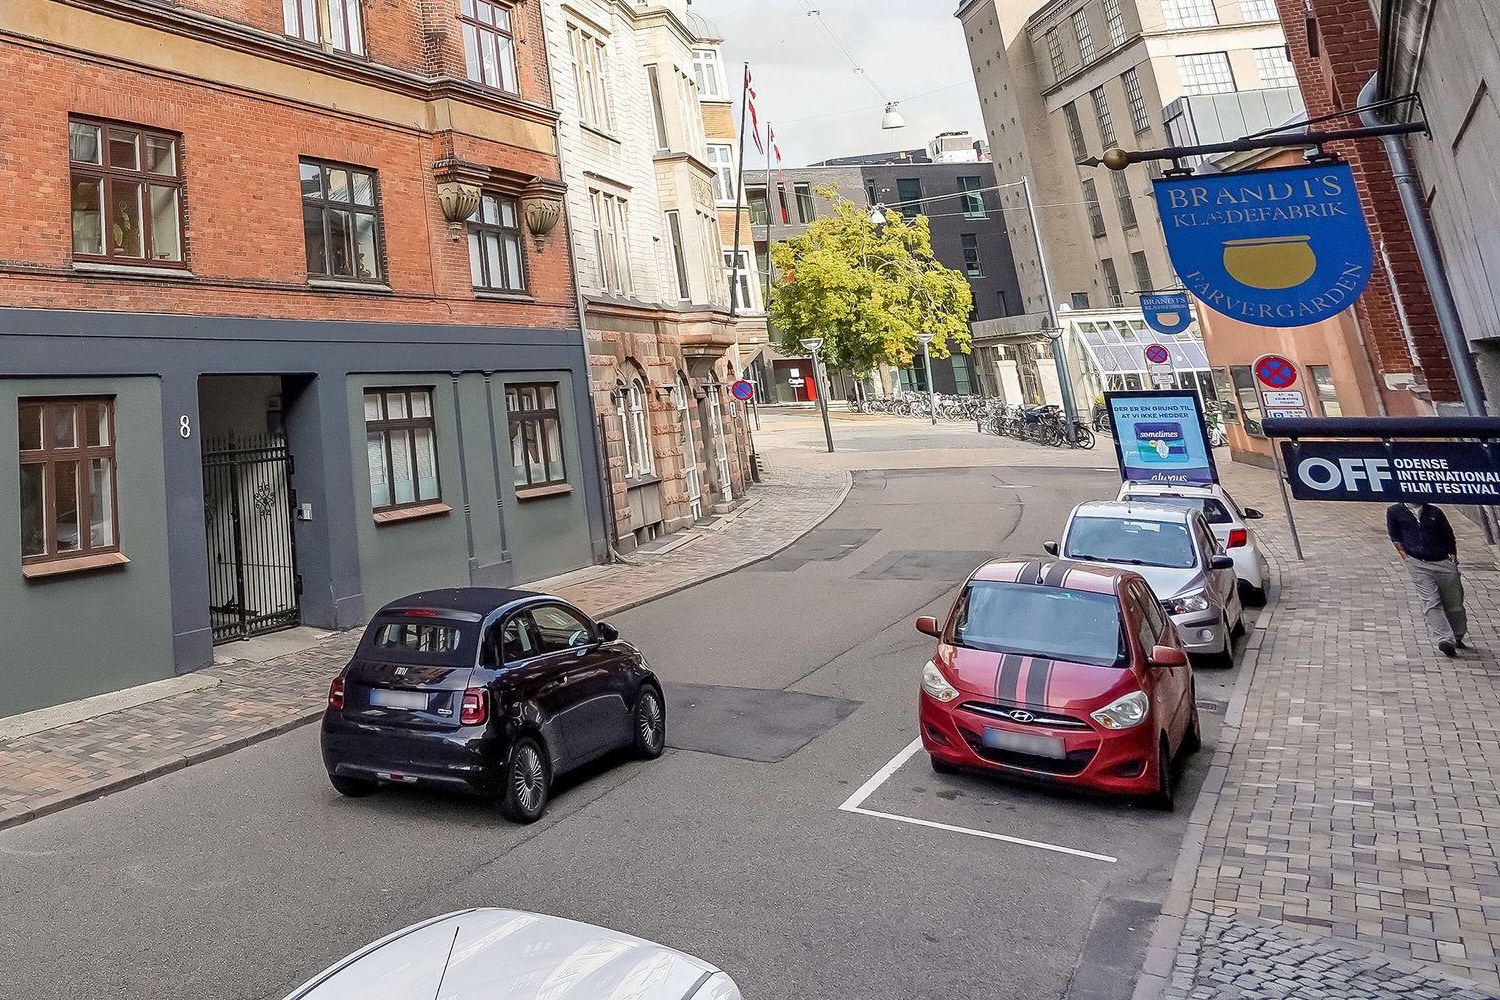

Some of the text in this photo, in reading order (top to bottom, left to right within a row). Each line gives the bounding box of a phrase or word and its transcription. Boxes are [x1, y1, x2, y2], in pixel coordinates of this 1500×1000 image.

[1173, 201, 1347, 227] KLÆDEFABRIK
[180, 415, 191, 438] 8
[1140, 430, 1178, 438] sometimes
[1393, 458, 1449, 469] ODENSE
[1297, 457, 1392, 492] OFF
[1396, 470, 1500, 483] INTERNATIONAL
[1400, 482, 1499, 495] FILM FESTIVAL
